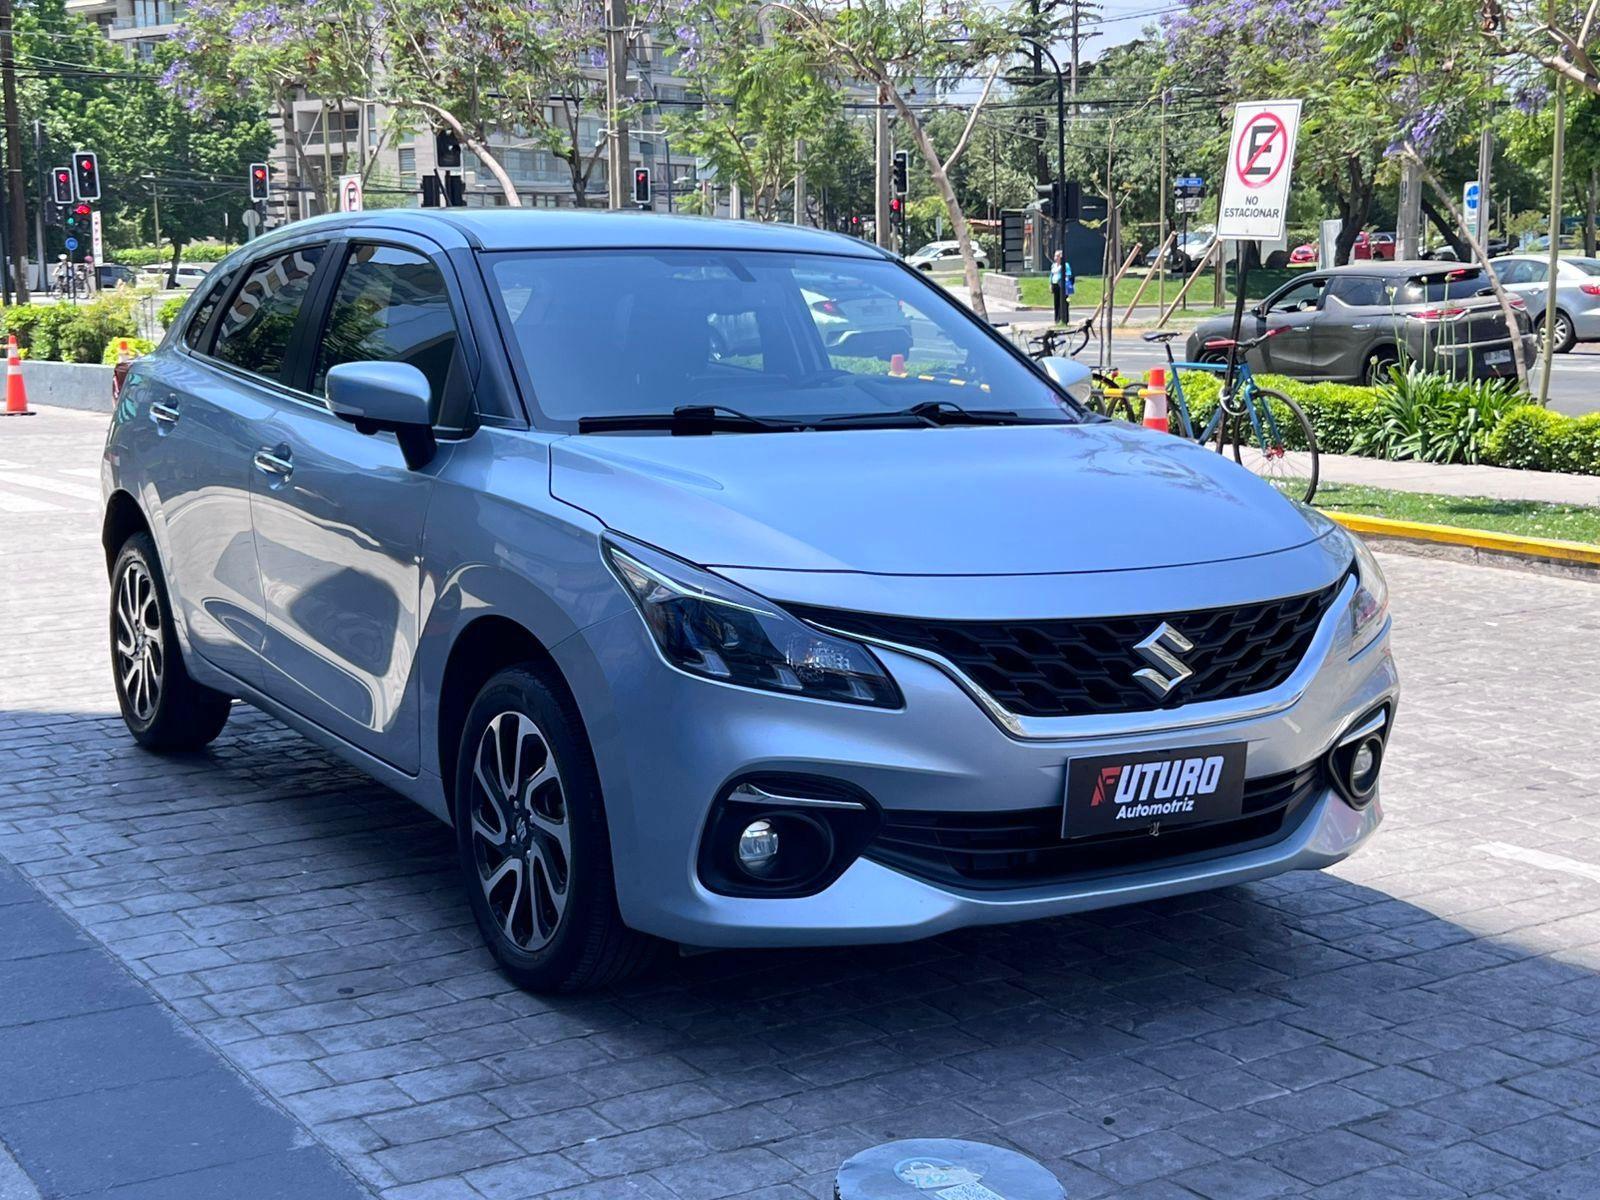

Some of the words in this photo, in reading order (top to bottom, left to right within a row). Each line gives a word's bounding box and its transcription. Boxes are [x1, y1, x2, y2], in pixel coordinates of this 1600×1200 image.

[1244, 195, 1259, 206] NO
[1224, 207, 1280, 219] ESTACIONAR
[1090, 756, 1225, 806] FUTURO
[1115, 797, 1195, 820] Automotriz
